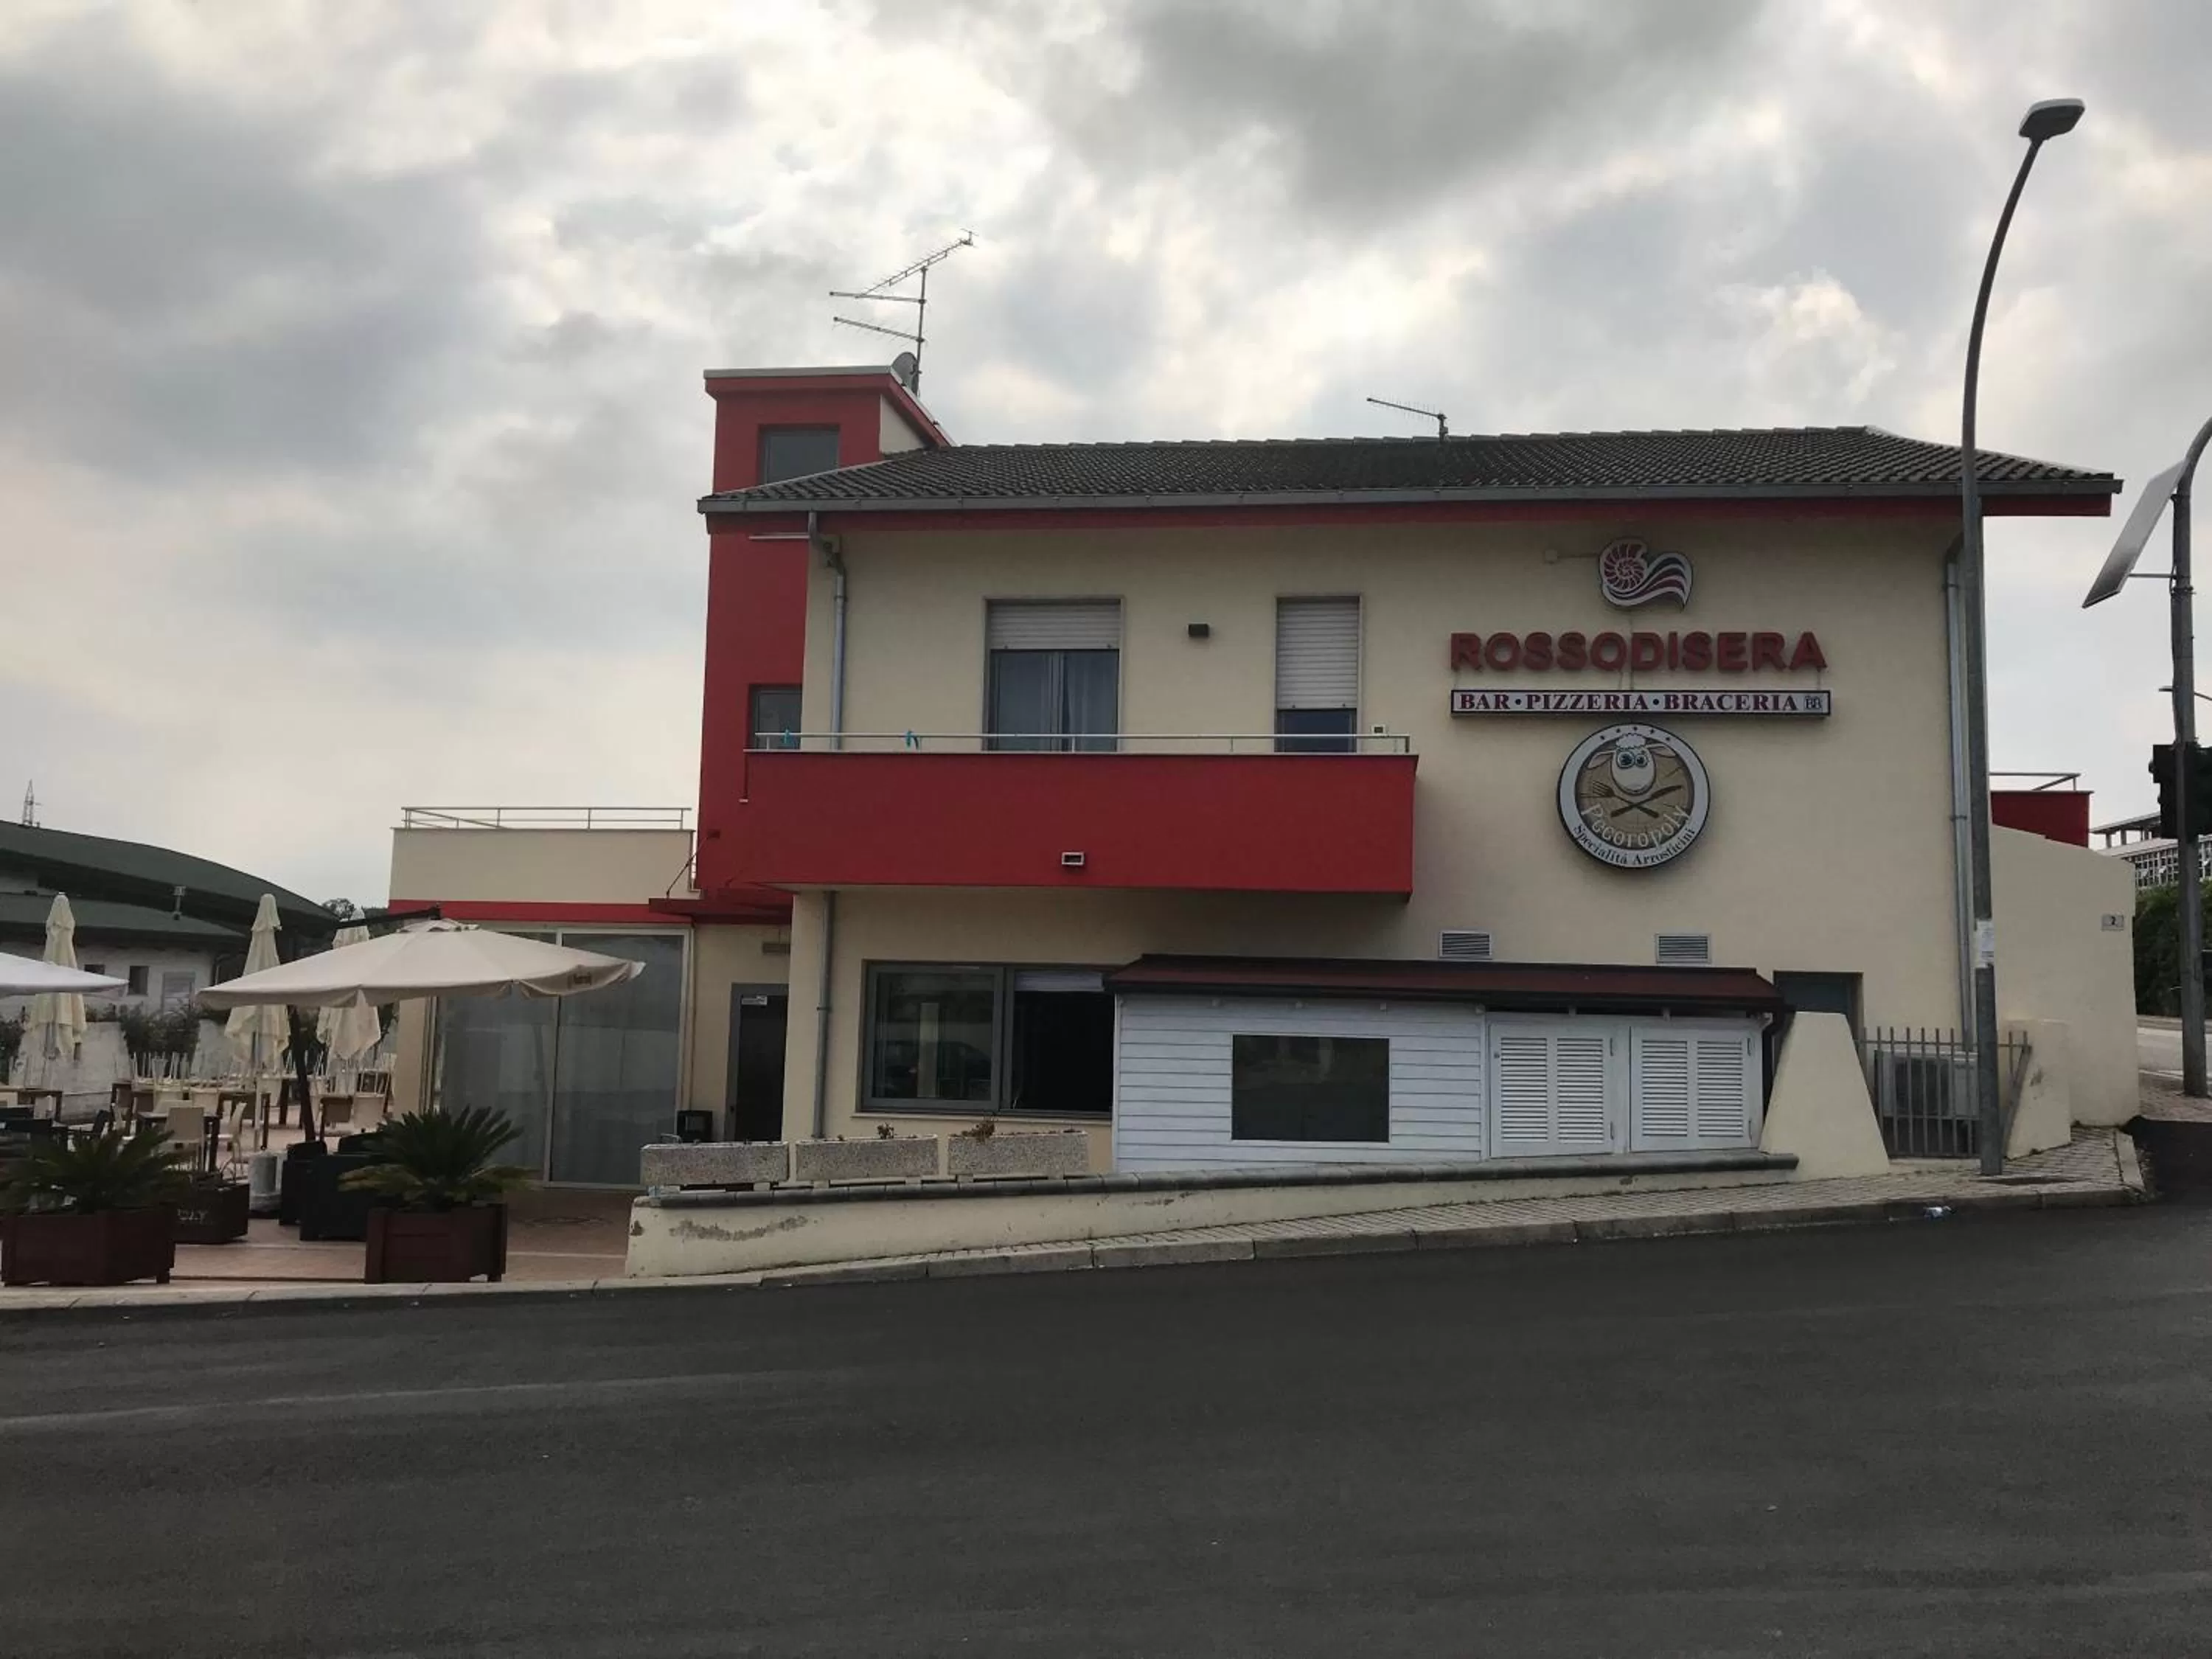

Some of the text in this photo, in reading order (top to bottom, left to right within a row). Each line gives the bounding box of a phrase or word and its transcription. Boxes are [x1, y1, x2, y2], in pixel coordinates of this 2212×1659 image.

[1450, 632, 1827, 671] ROSSODISERA
[1460, 694, 1798, 710] BAR PIZZERIA BRACERIA
[1581, 803, 1691, 848] Pecoropoly
[1632, 827, 1696, 866] Arrosticini
